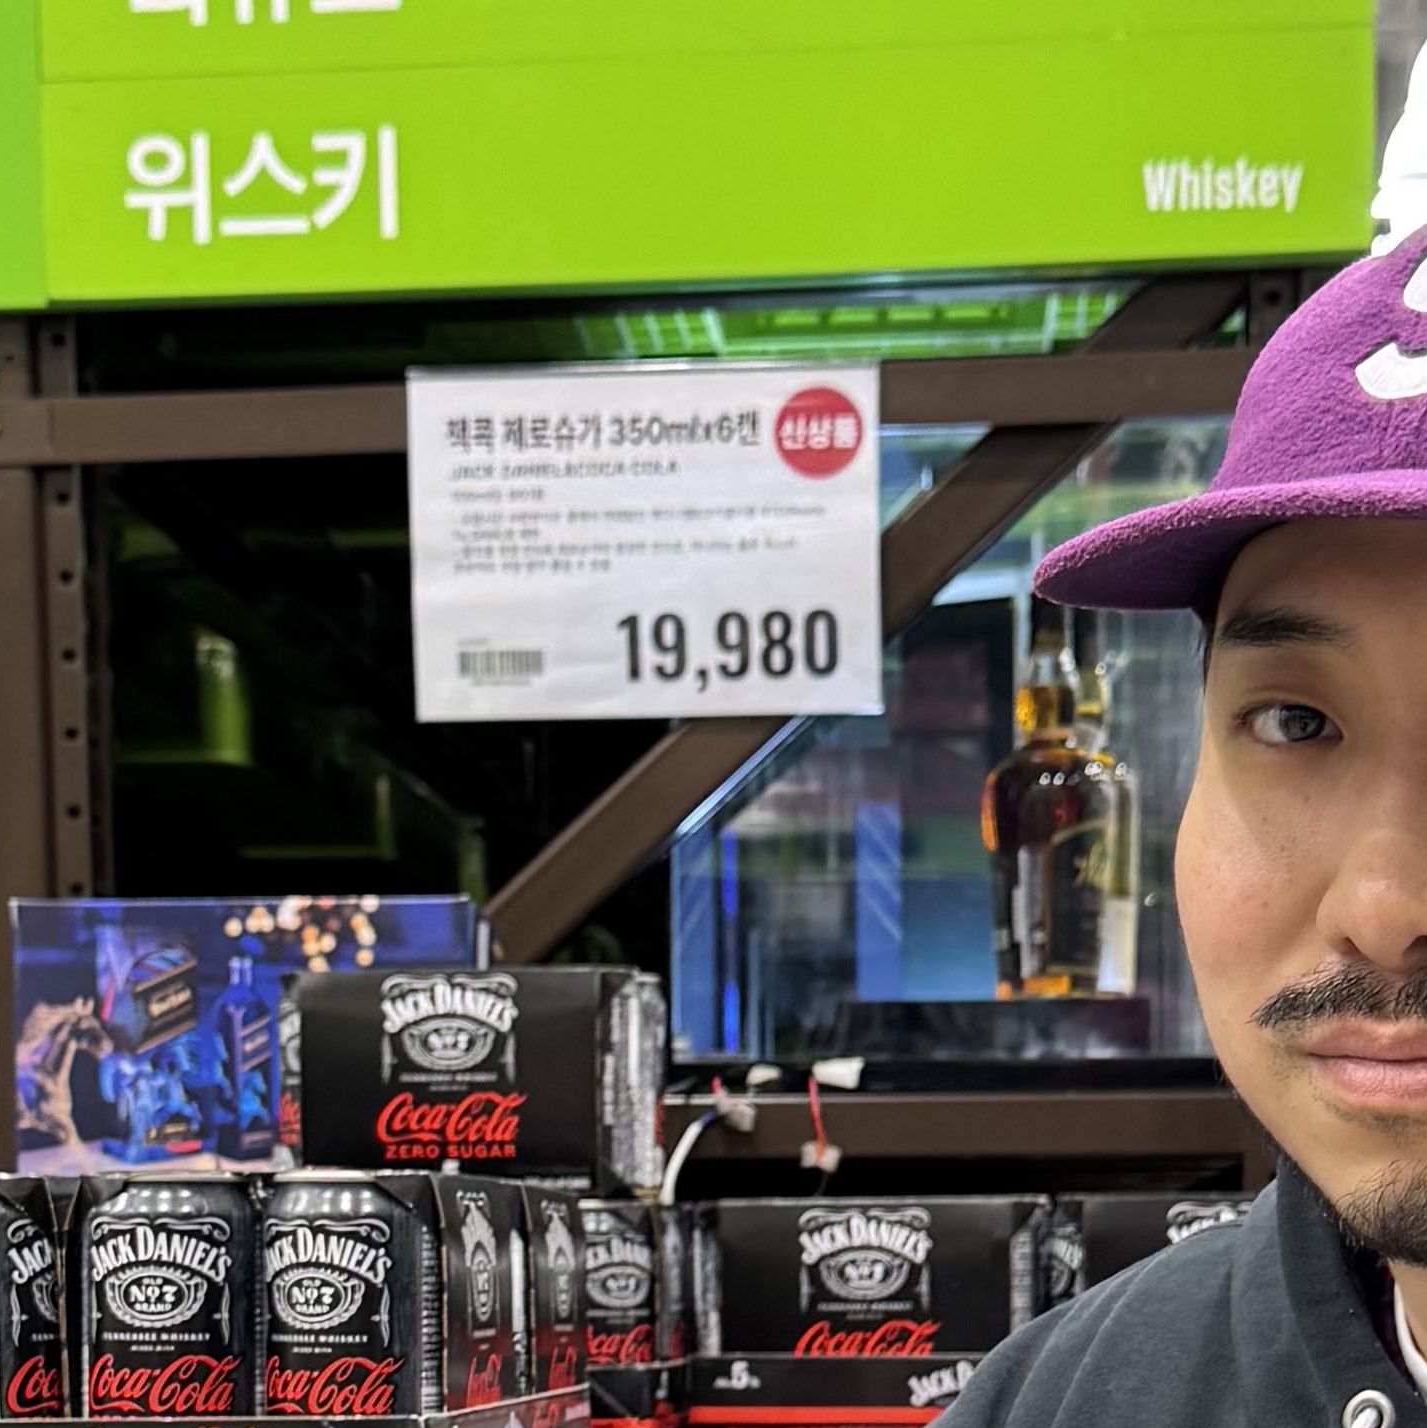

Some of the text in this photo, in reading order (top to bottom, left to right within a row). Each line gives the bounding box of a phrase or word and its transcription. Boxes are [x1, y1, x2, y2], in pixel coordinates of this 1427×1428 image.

[123, 123, 400, 246] 위스키
[1142, 156, 1304, 213] Whiskey
[778, 412, 859, 452] 신상품
[616, 609, 838, 692] 19,980
[381, 992, 434, 1033] JACK
[377, 1092, 527, 1147] Coca-Cola
[385, 1144, 516, 1159] ZERO SUGAR
[91, 1225, 233, 1283] JACK DANIEL'S
[89, 1354, 243, 1414] Coca-Cola
